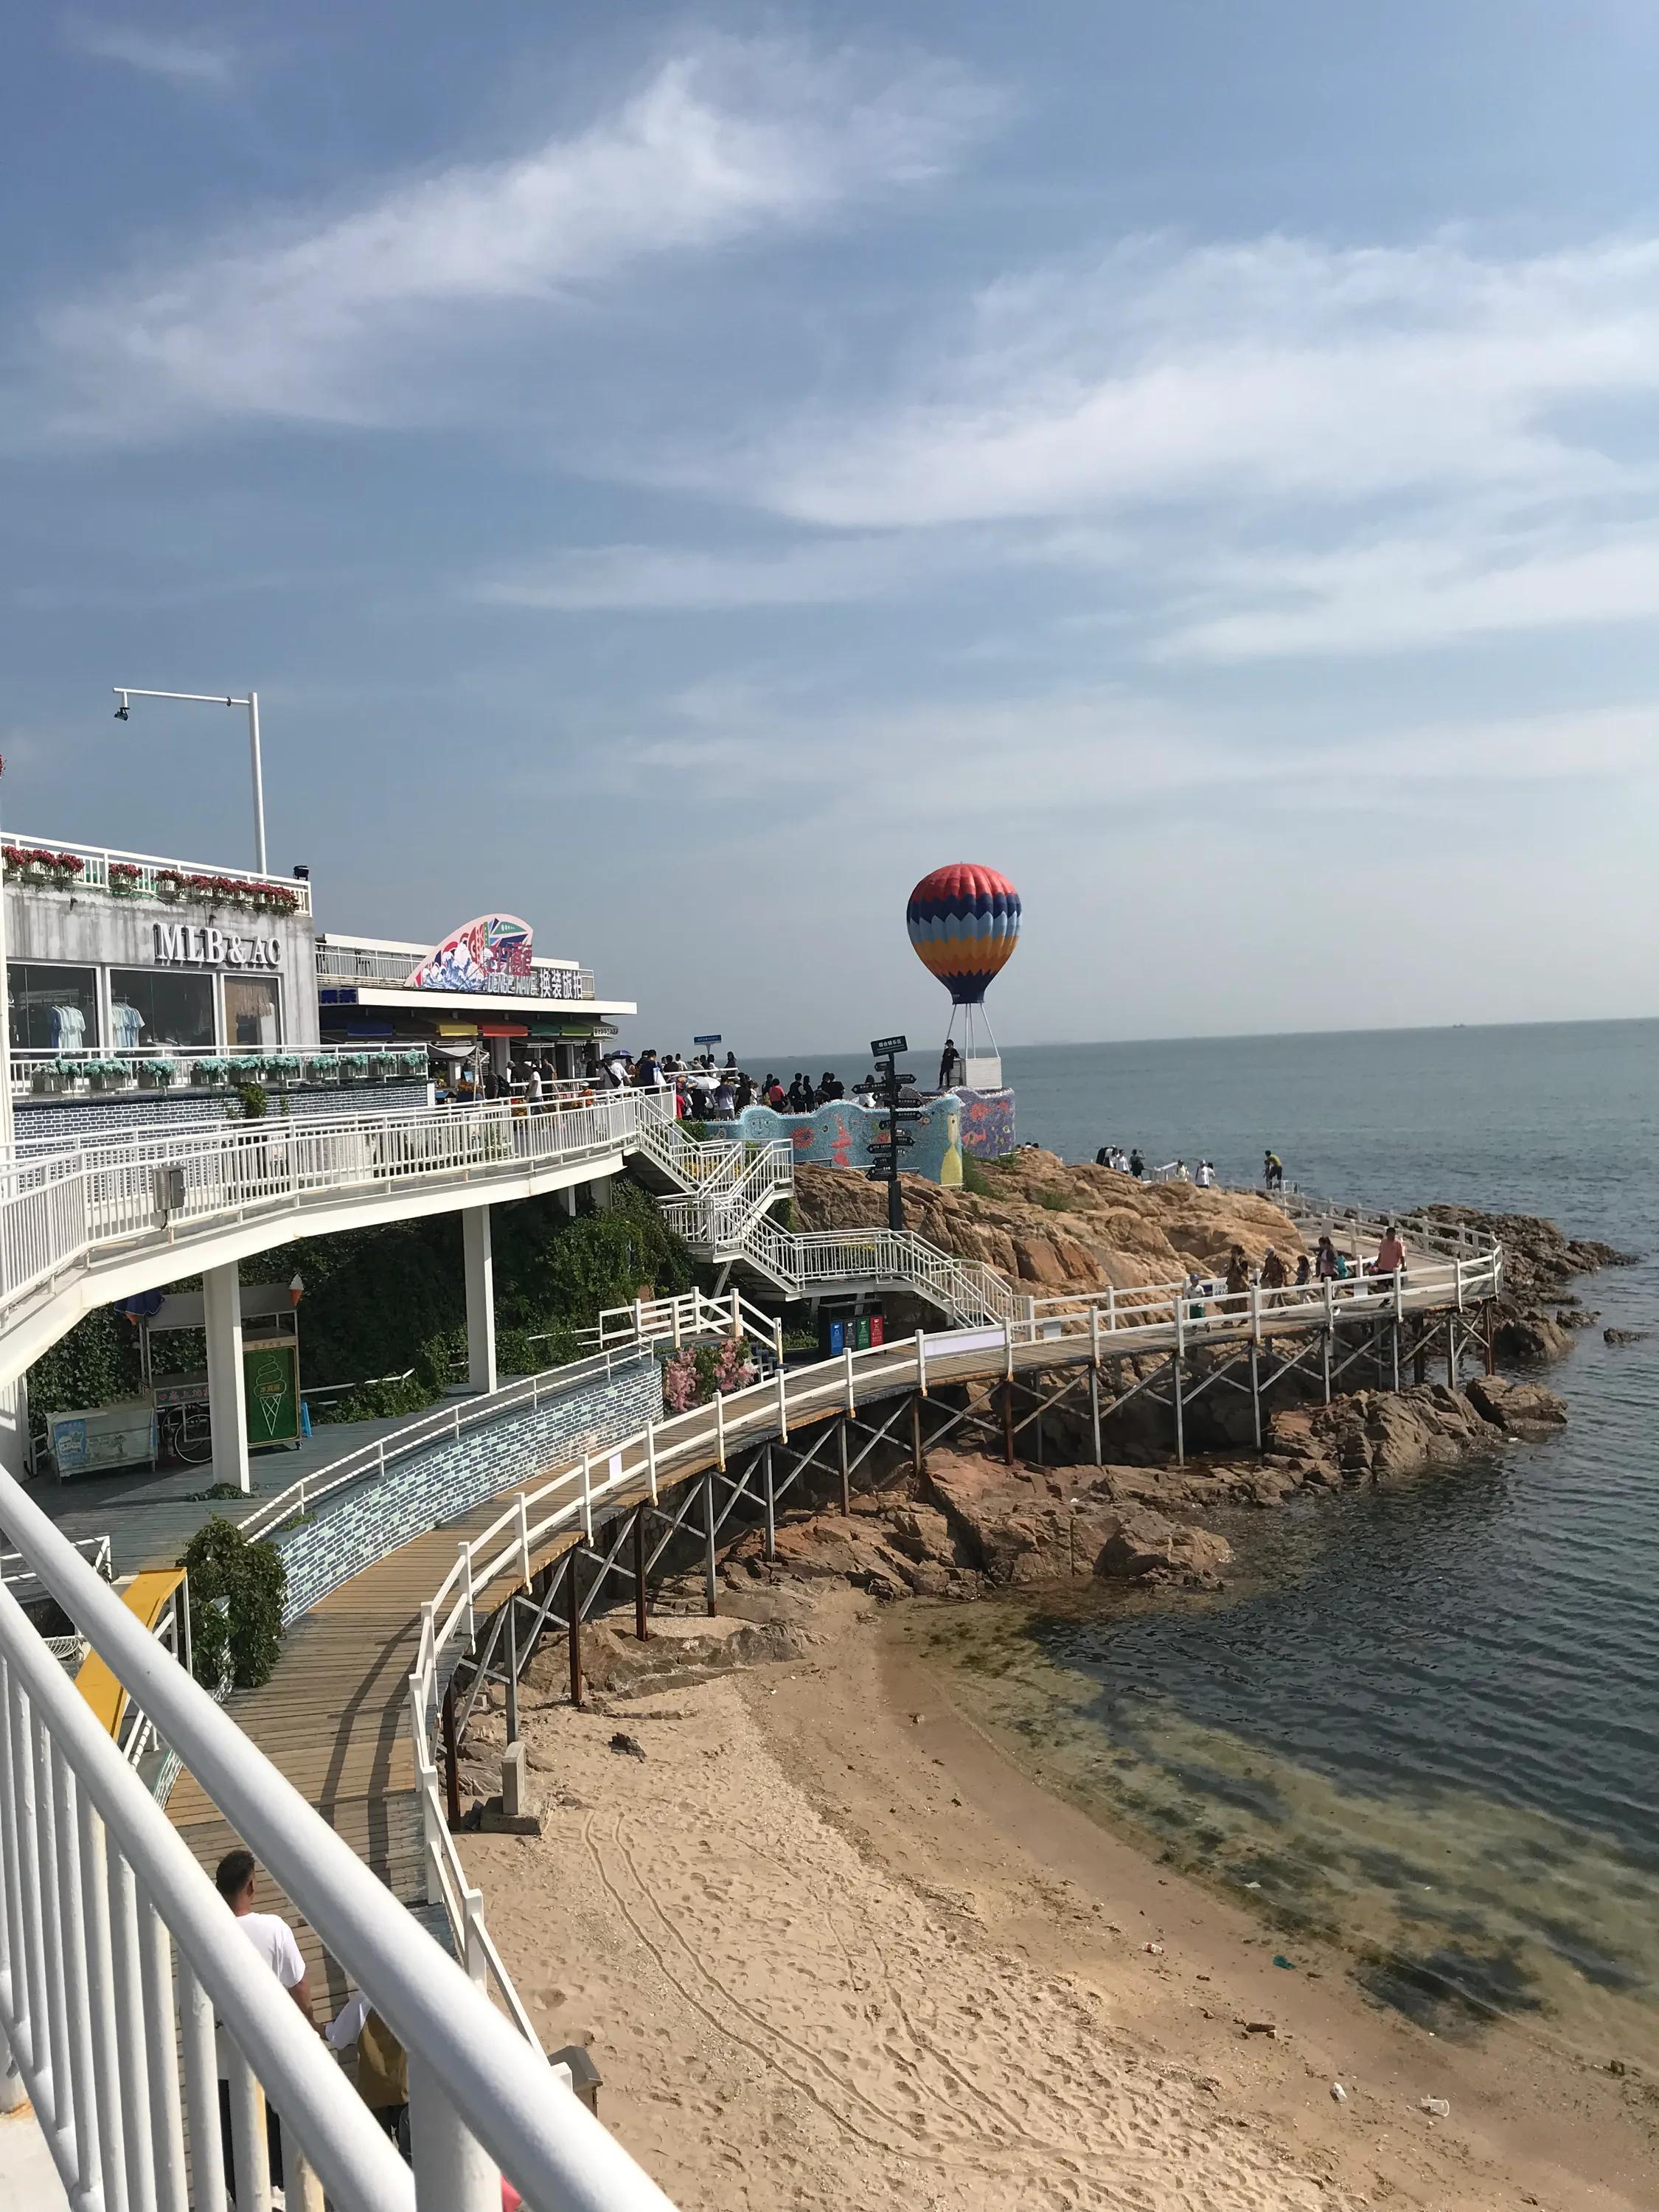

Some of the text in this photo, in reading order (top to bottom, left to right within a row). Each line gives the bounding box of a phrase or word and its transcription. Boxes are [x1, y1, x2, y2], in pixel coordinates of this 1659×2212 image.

[154, 922, 224, 963] MLB
[229, 935, 247, 963] &
[540, 968, 582, 1000] 换装旅拍
